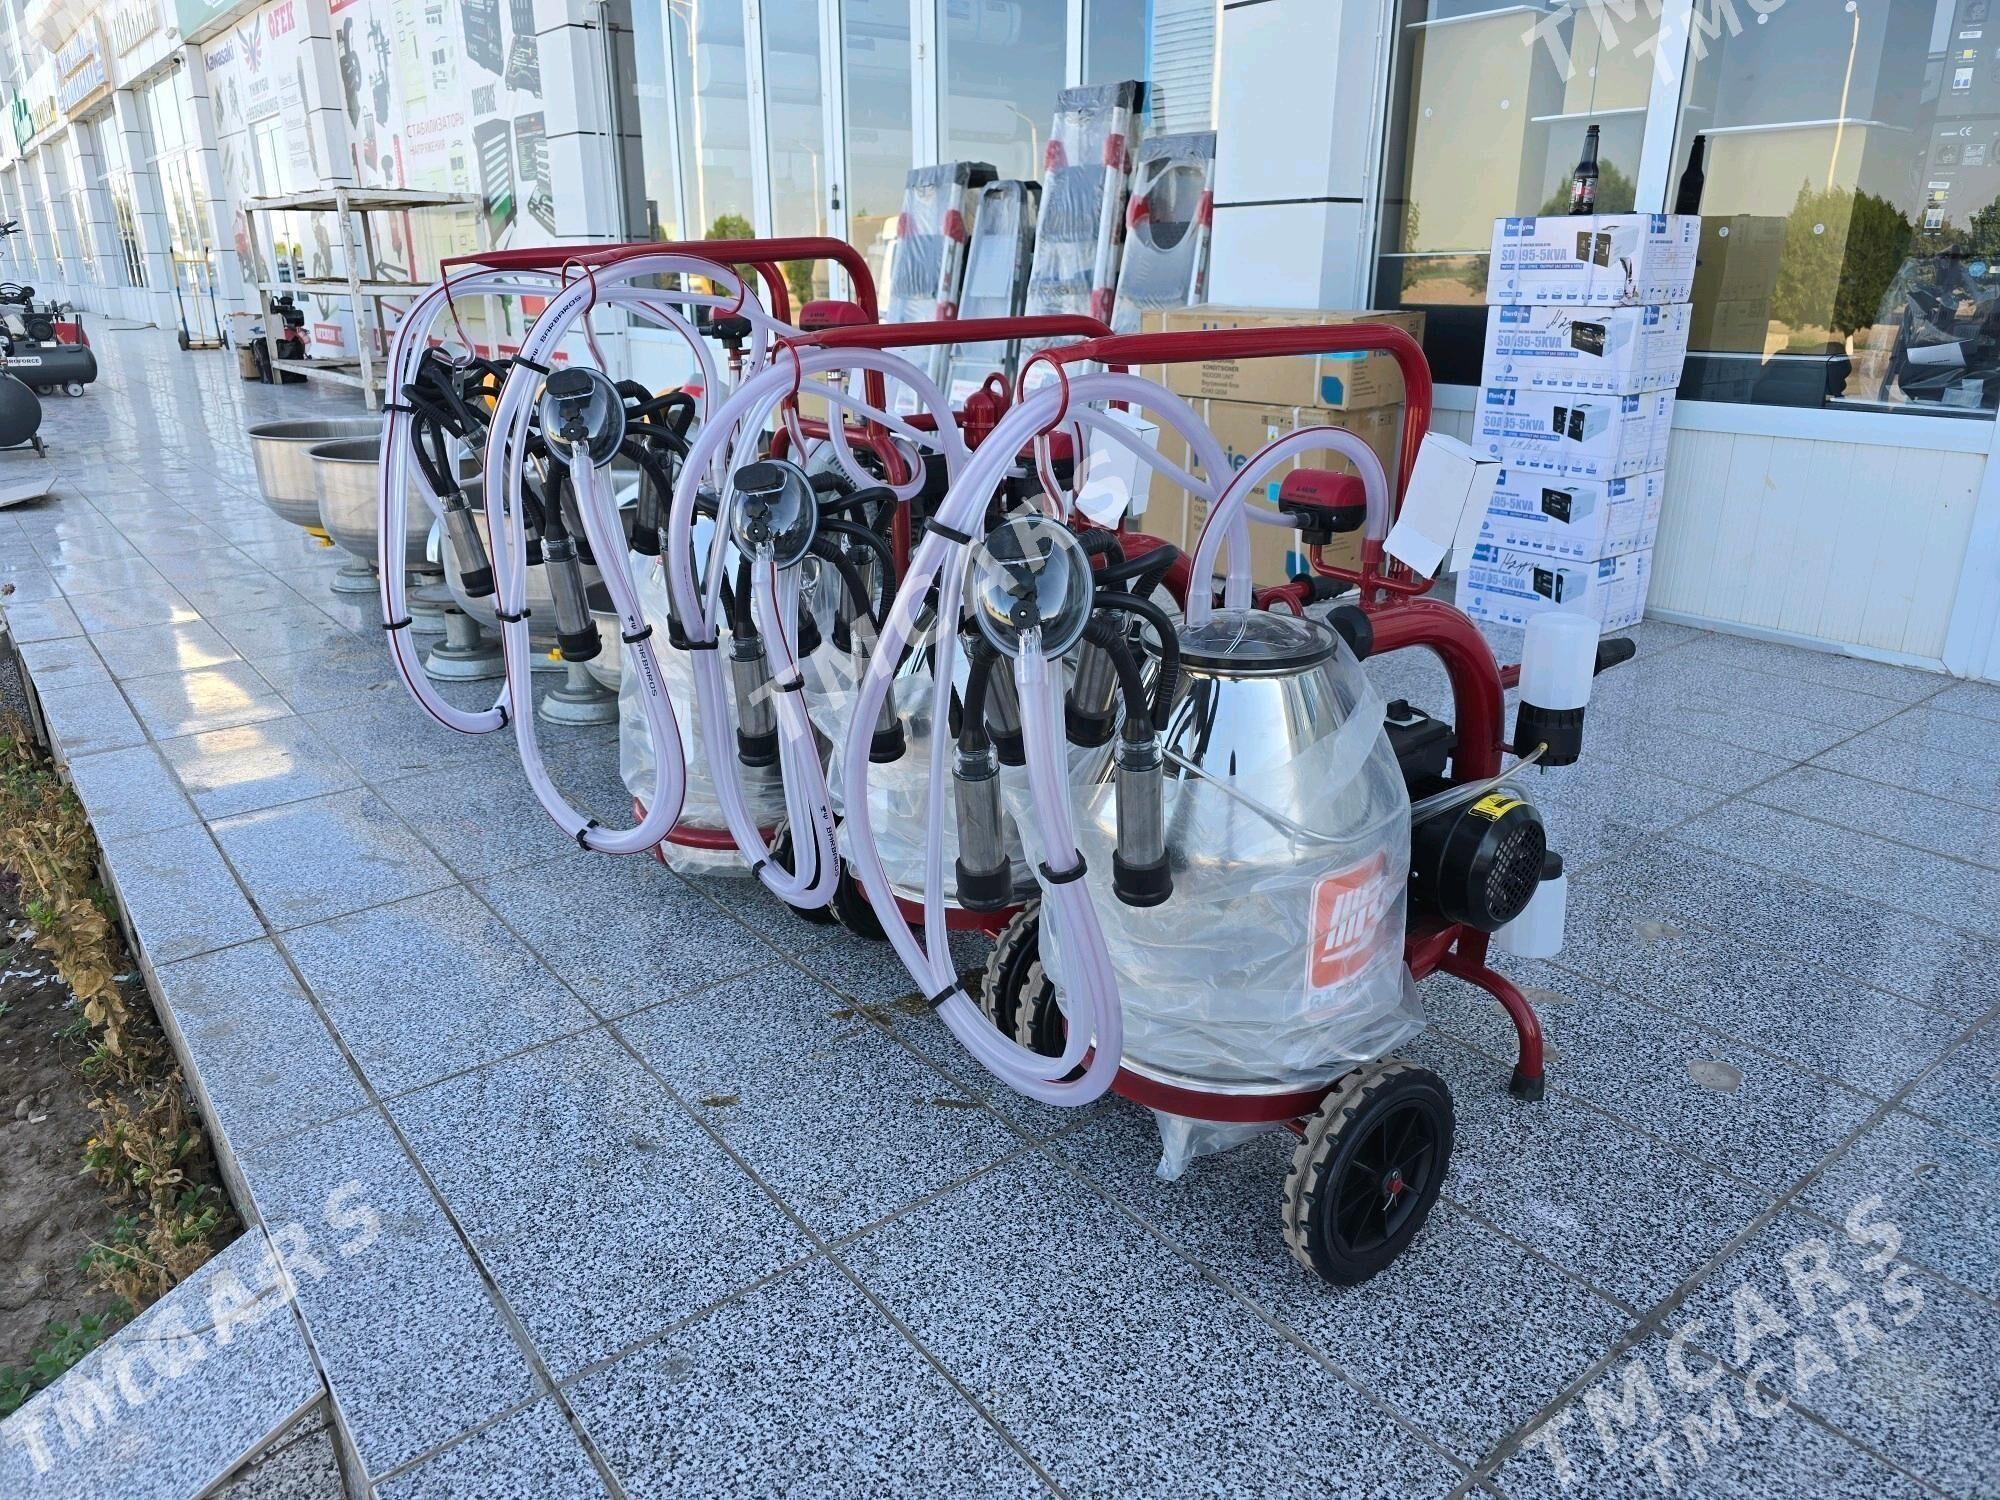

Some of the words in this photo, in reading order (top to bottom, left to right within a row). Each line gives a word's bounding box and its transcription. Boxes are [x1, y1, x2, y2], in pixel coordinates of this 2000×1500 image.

[204, 39, 235, 73] Kawasaki
[539, 294, 582, 343] BARBAROS
[825, 826, 841, 877] BARBAROS
